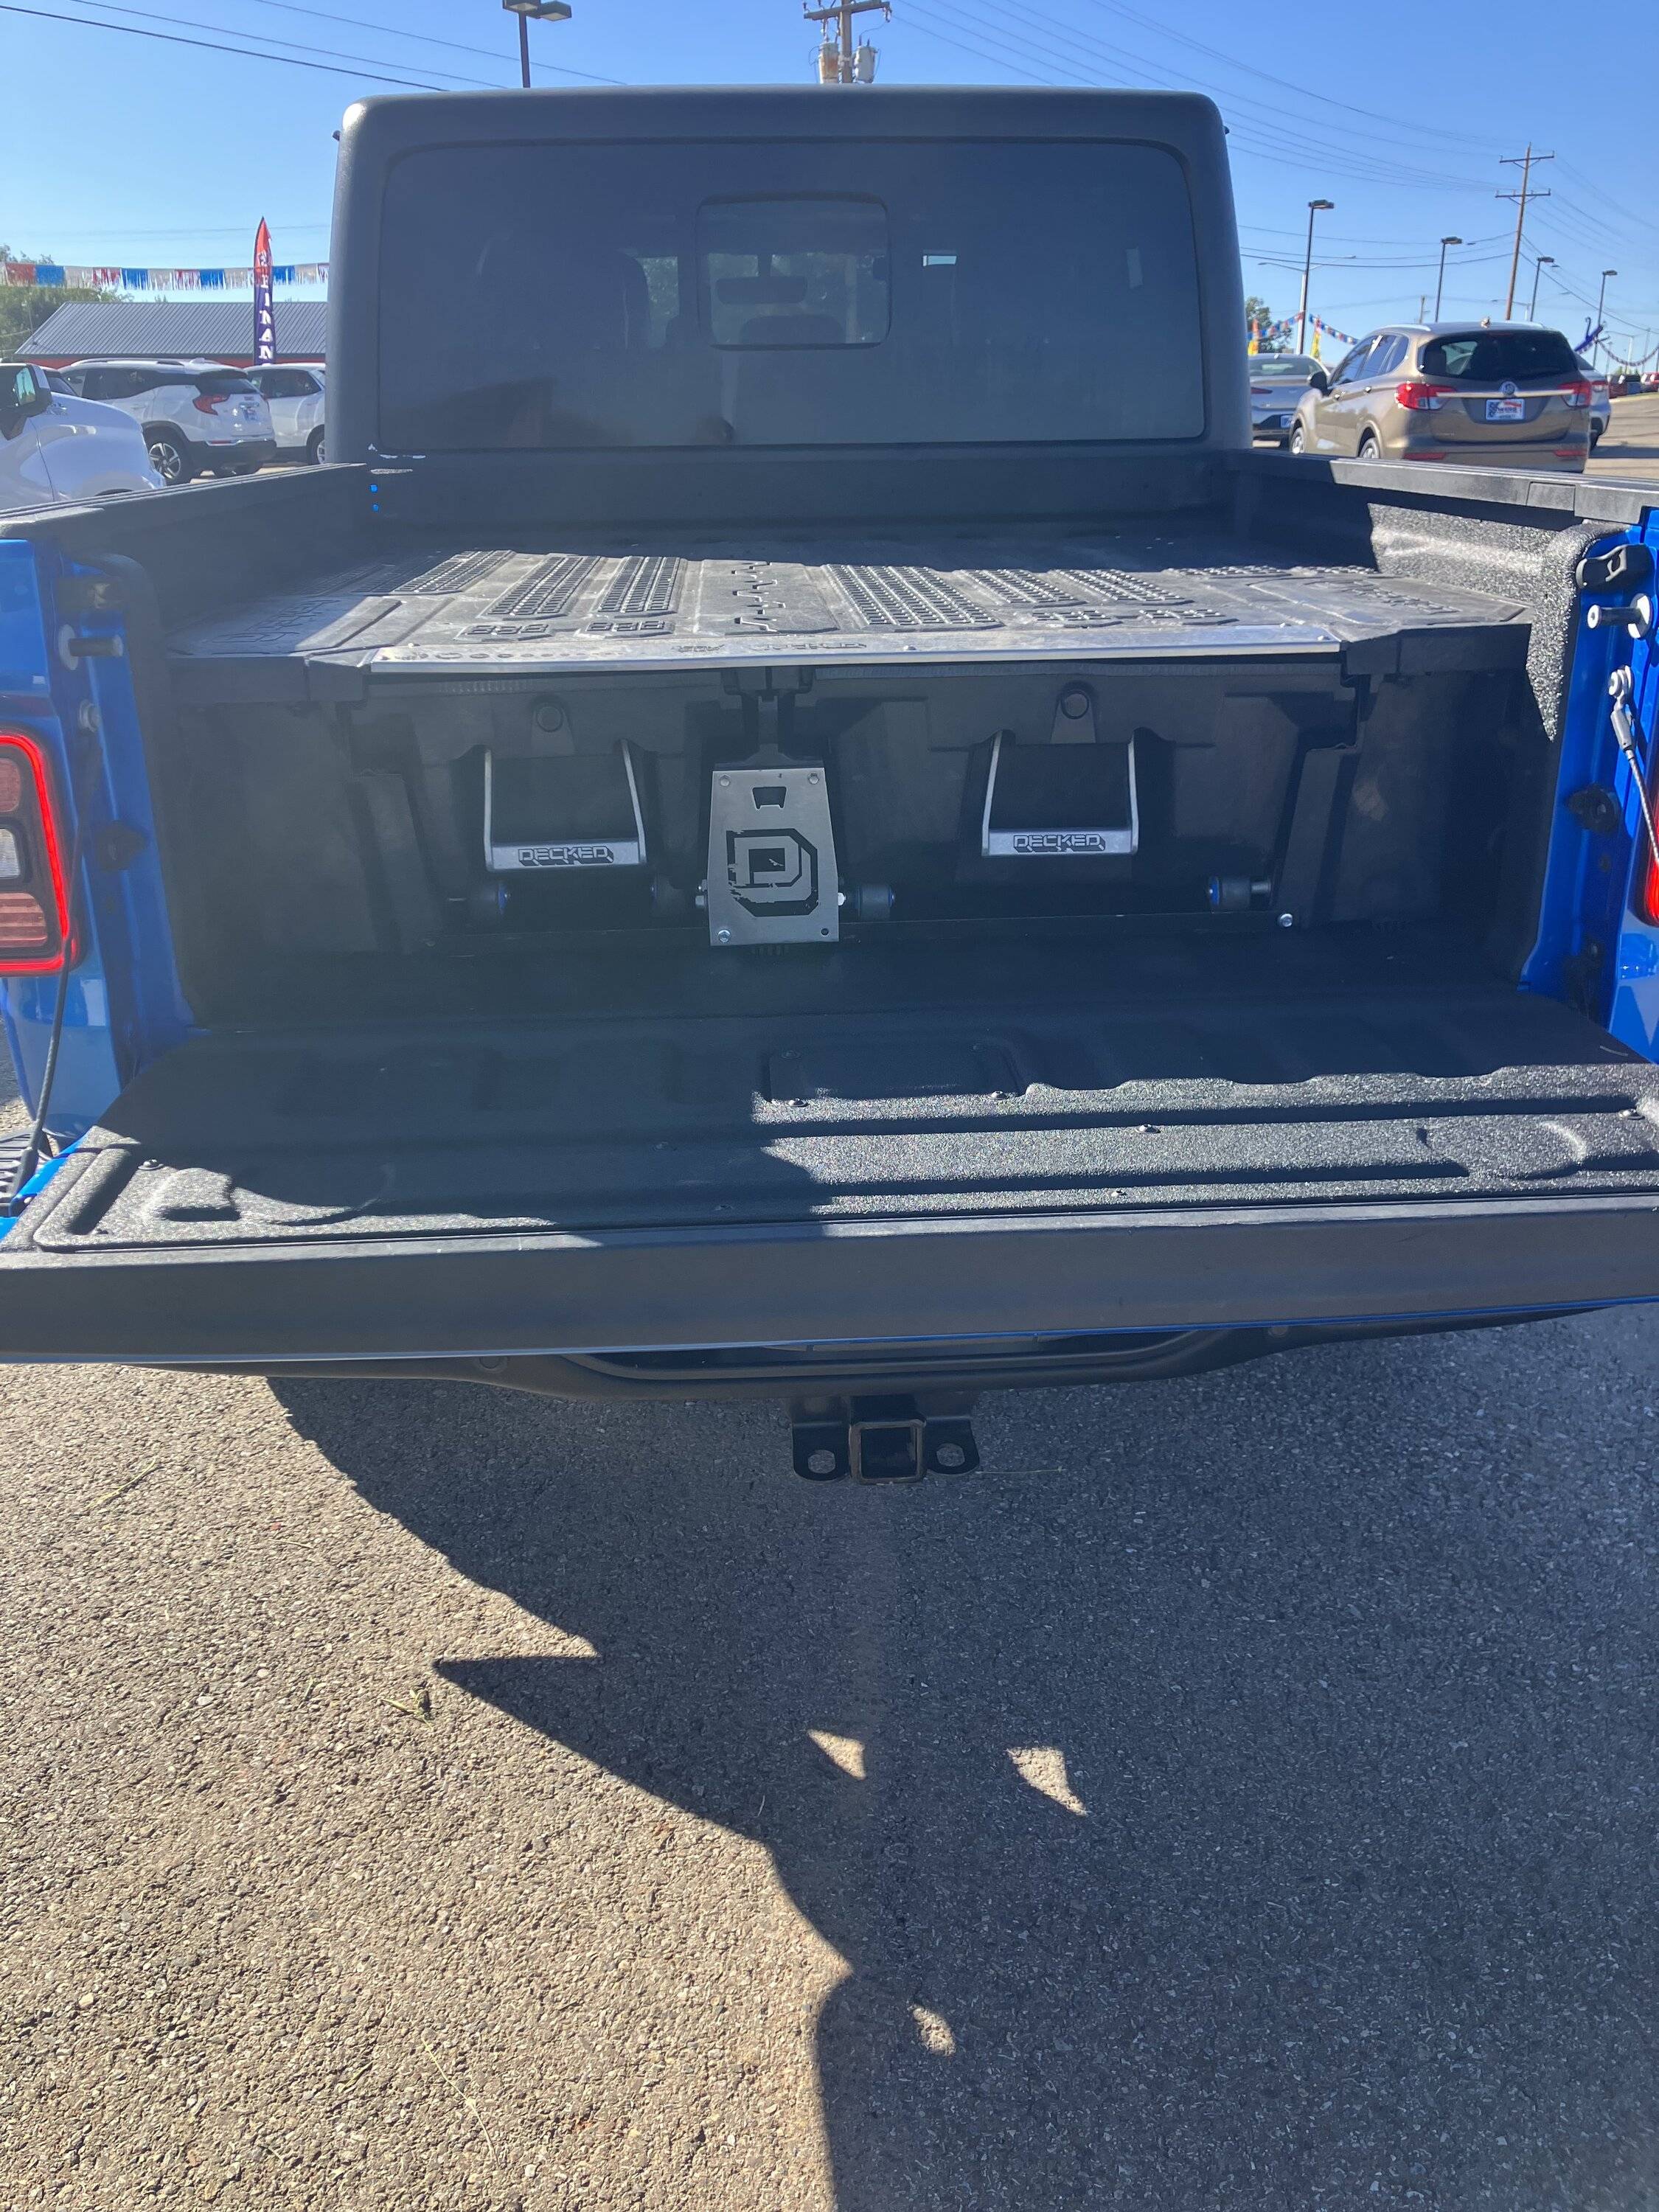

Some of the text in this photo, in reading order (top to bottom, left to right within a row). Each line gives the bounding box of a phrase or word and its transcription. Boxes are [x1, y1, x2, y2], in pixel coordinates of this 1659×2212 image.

[258, 274, 274, 366] FINAN
[1014, 834, 1105, 852] DECKED
[518, 846, 613, 866] DECKED
